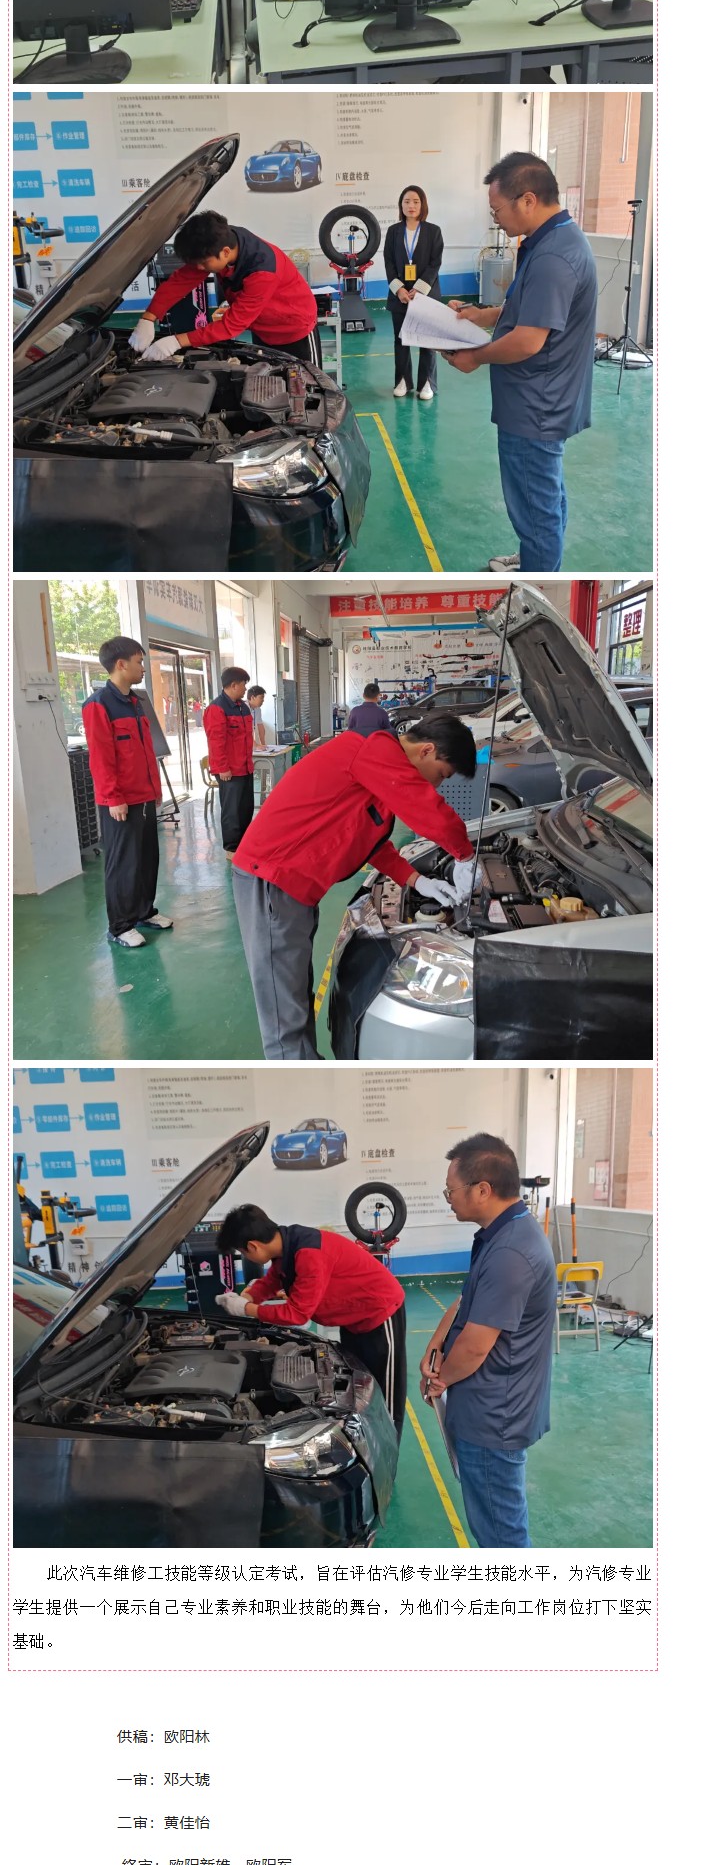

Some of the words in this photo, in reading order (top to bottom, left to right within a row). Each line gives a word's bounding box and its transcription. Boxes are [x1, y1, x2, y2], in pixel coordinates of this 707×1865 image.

[338, 596, 429, 612] 注重技能培养
[622, 608, 643, 639] 整理
[47, 1565, 651, 1581] 此次汽车维修工技能等级认定考试，旨在评估汽修专业学生技能水平，为汽修专业
[13, 1599, 651, 1615] 学生提供一个展示自己专业素养和职业技能的舞台，为他们今后走向工作岗位打下坚实
[13, 1633, 57, 1649] 基础。
